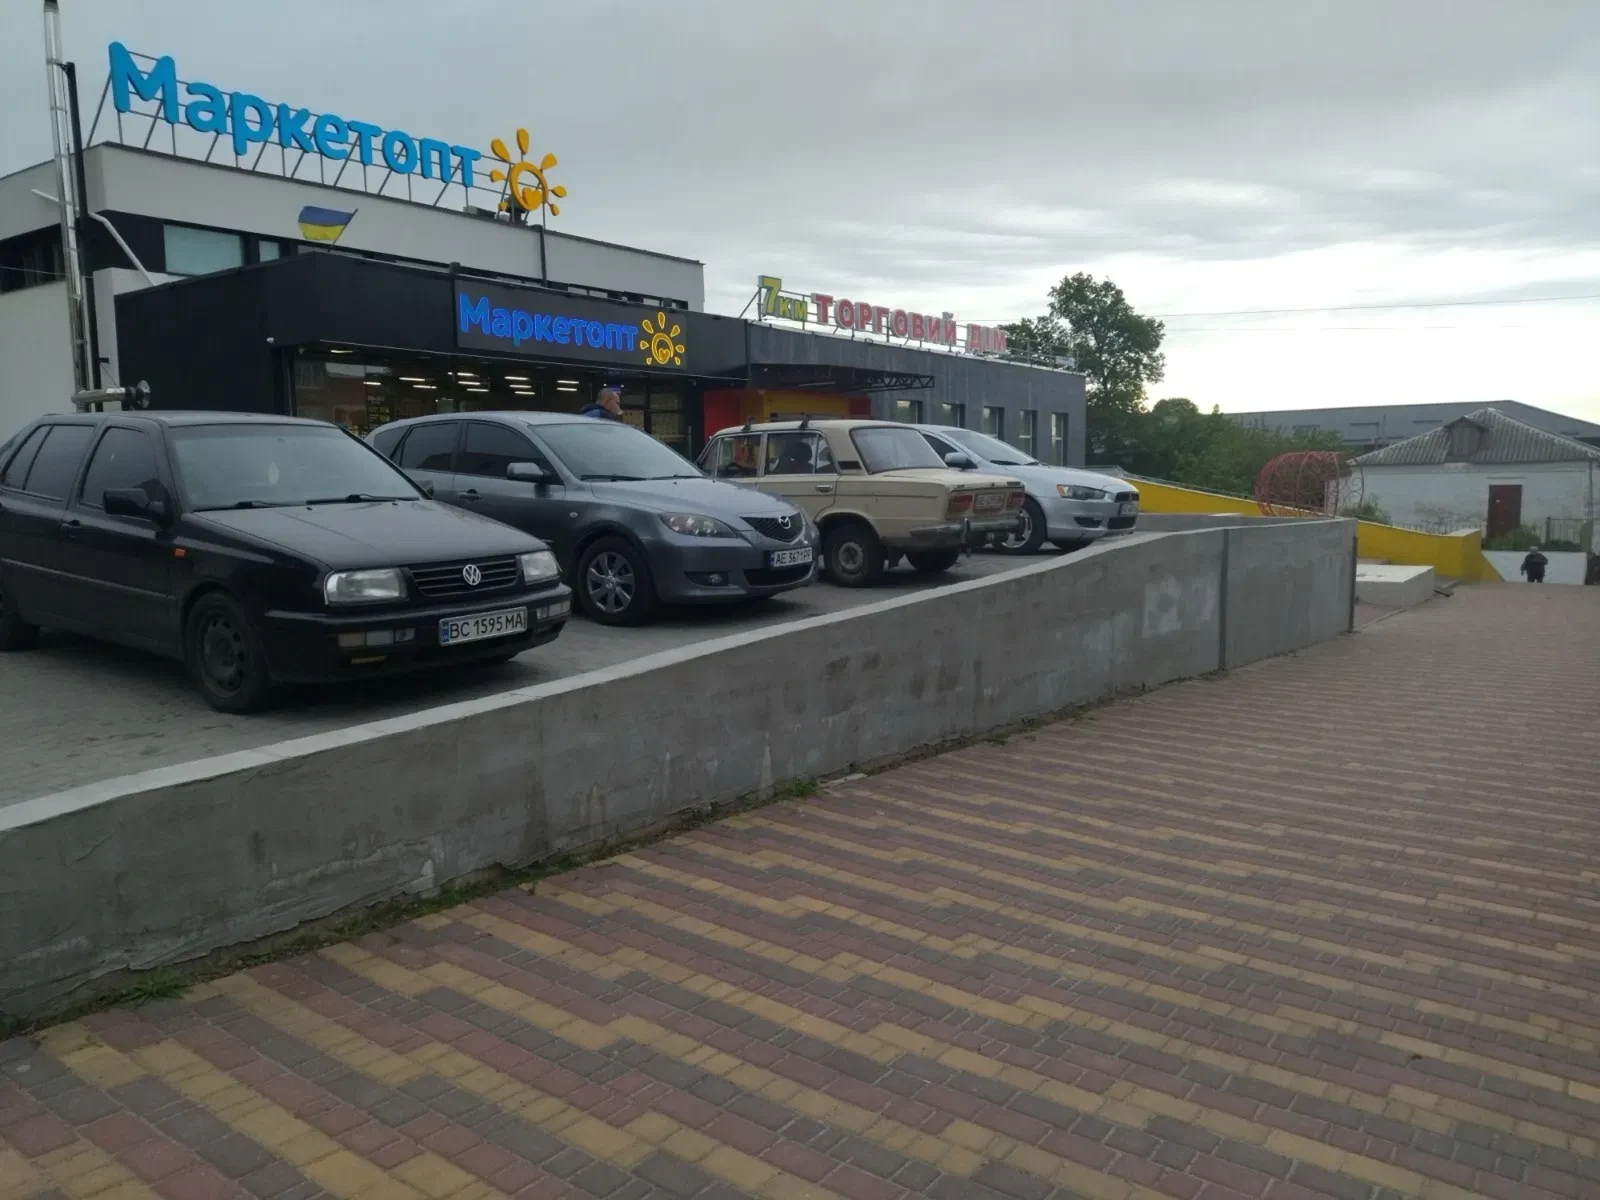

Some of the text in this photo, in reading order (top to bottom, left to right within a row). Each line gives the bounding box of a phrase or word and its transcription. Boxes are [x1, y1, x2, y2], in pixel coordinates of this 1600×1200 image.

[108, 41, 482, 188] Маркетопт
[459, 291, 639, 352] Маркетопт
[811, 293, 957, 346] ТОРГОВИЙ
[965, 323, 1006, 353] ДІМ
[450, 622, 470, 639] BC
[473, 616, 503, 635] 1595
[505, 613, 523, 630] MA
